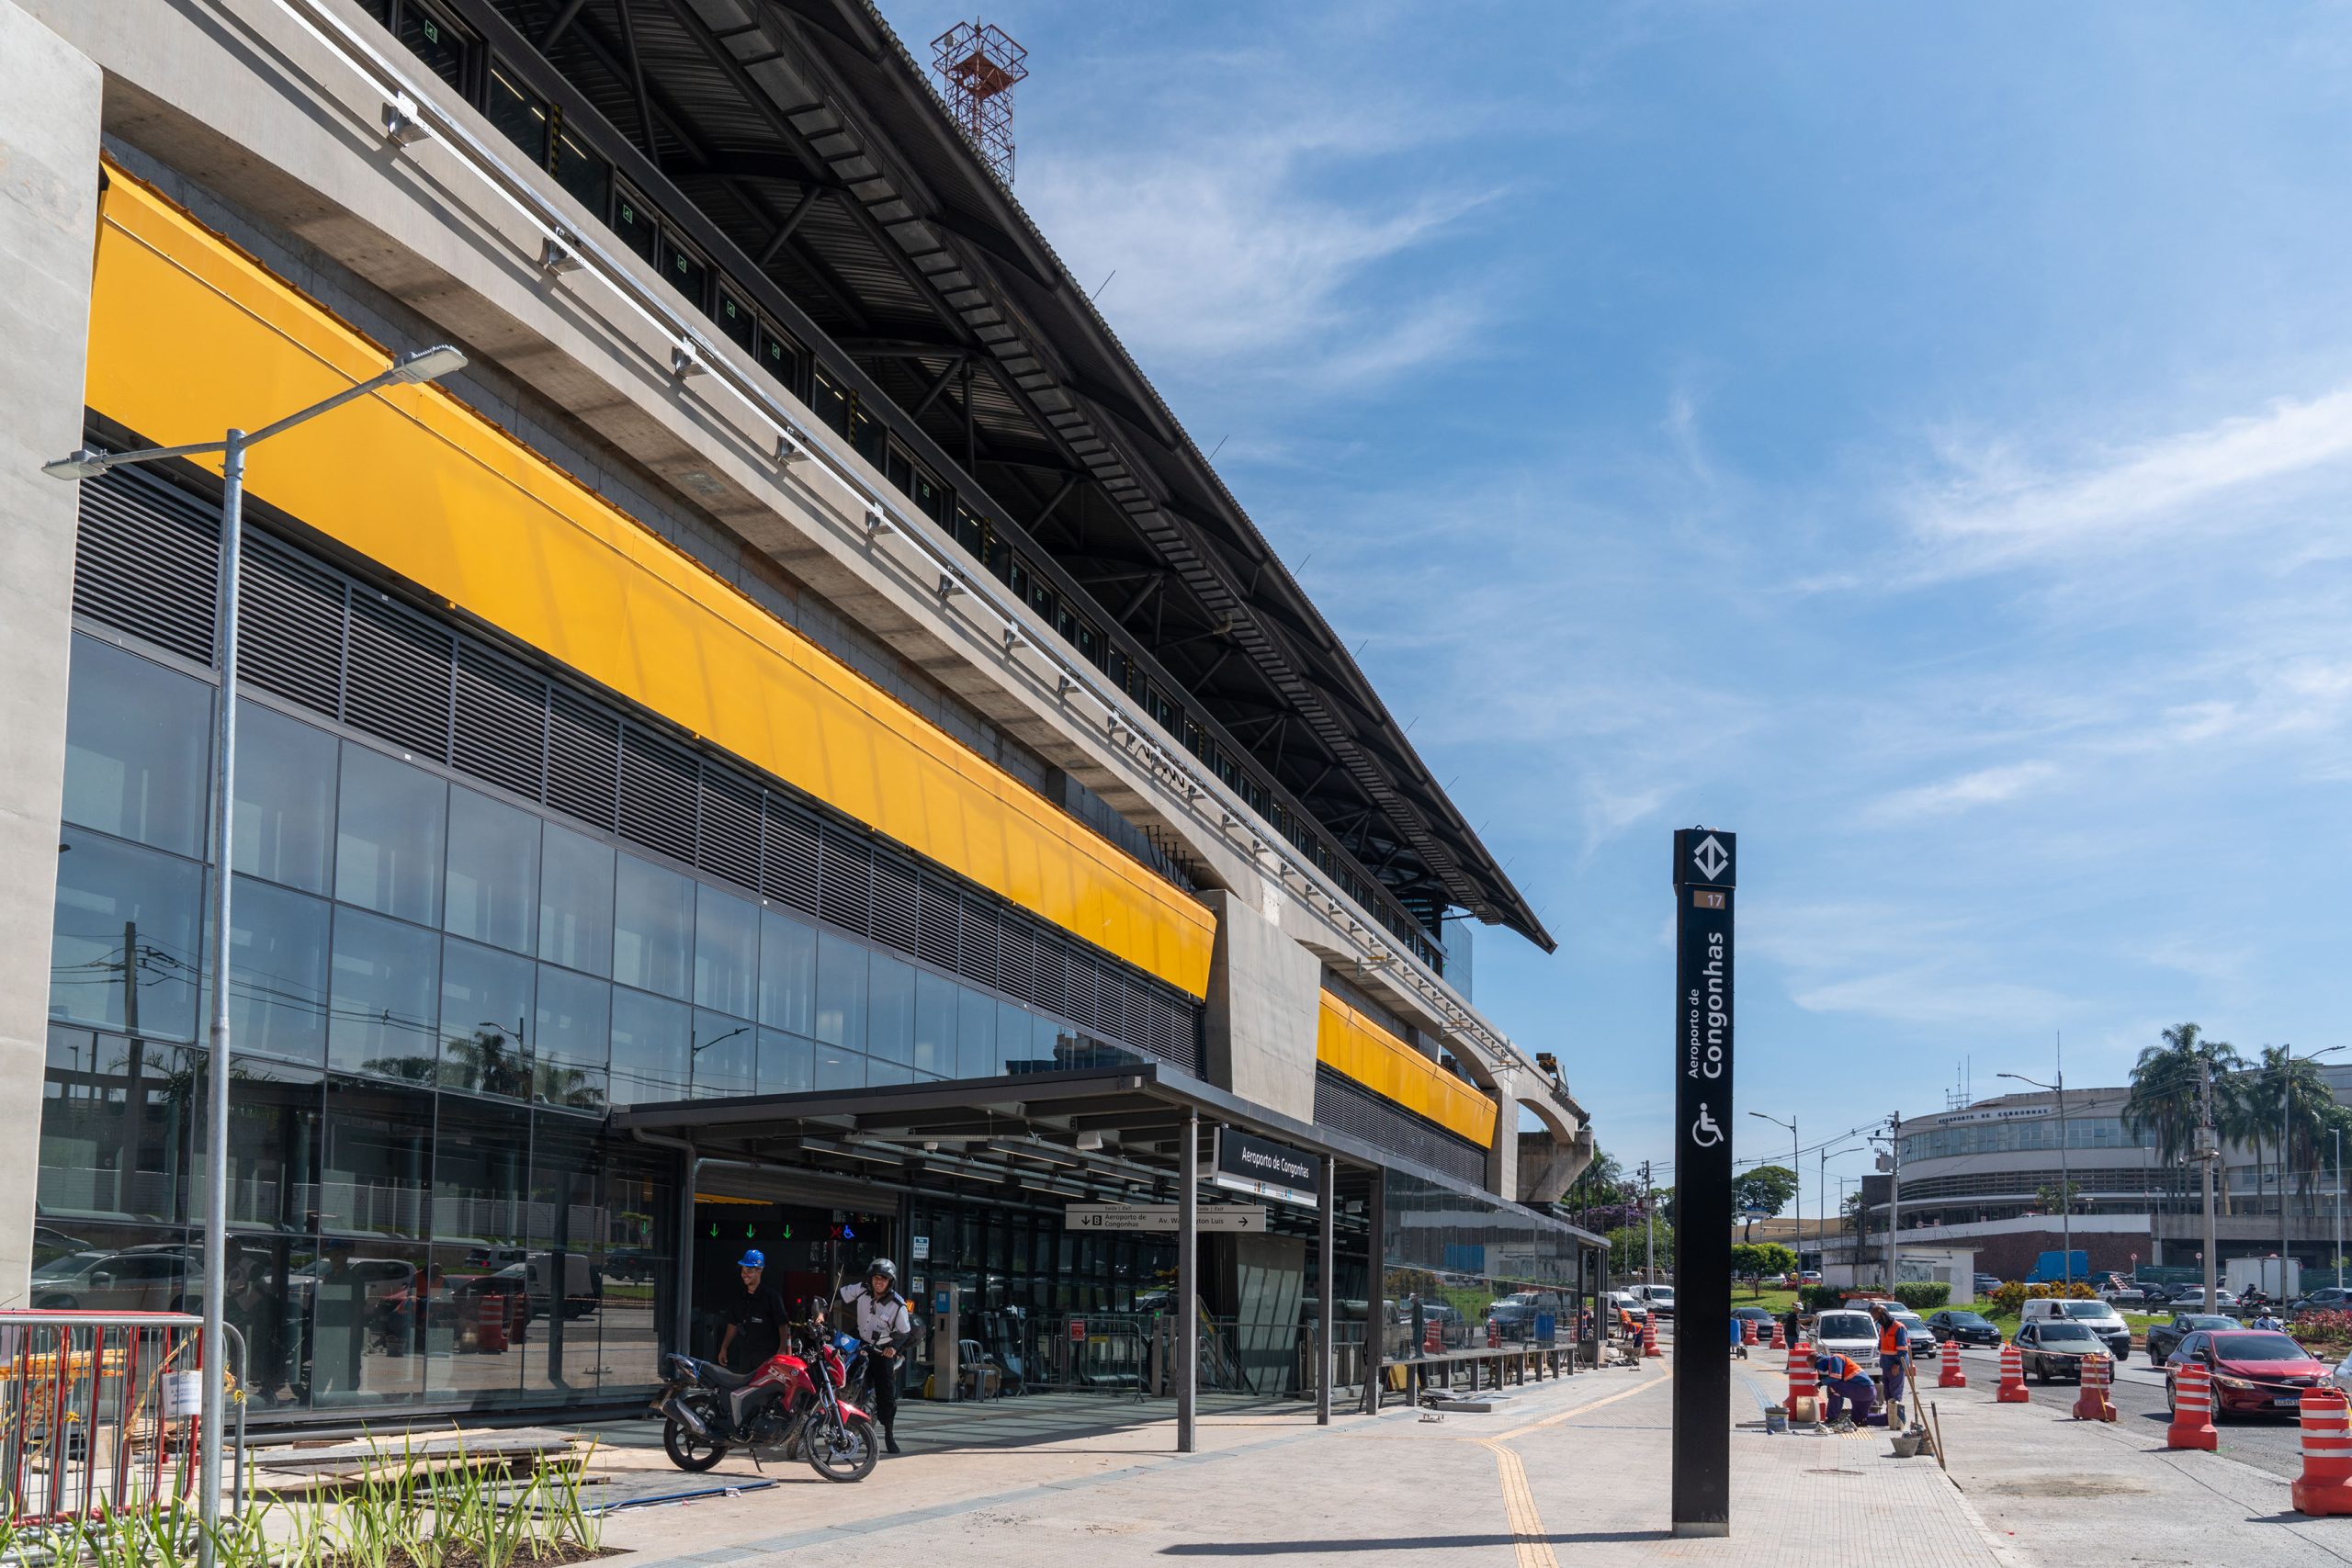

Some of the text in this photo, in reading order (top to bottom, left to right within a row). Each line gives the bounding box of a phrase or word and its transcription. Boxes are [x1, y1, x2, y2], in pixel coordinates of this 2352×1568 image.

[1707, 894, 1723, 907] 17
[1702, 931, 1727, 1079] Congonhas
[1688, 988, 1702, 1079] Aeroporto de
[1241, 1145, 1309, 1179] Aeroporto de Congonhas
[1093, 1215, 1101, 1225] B
[1104, 1213, 1137, 1222] Aeroporto
[1104, 1221, 1139, 1229] Congonhas
